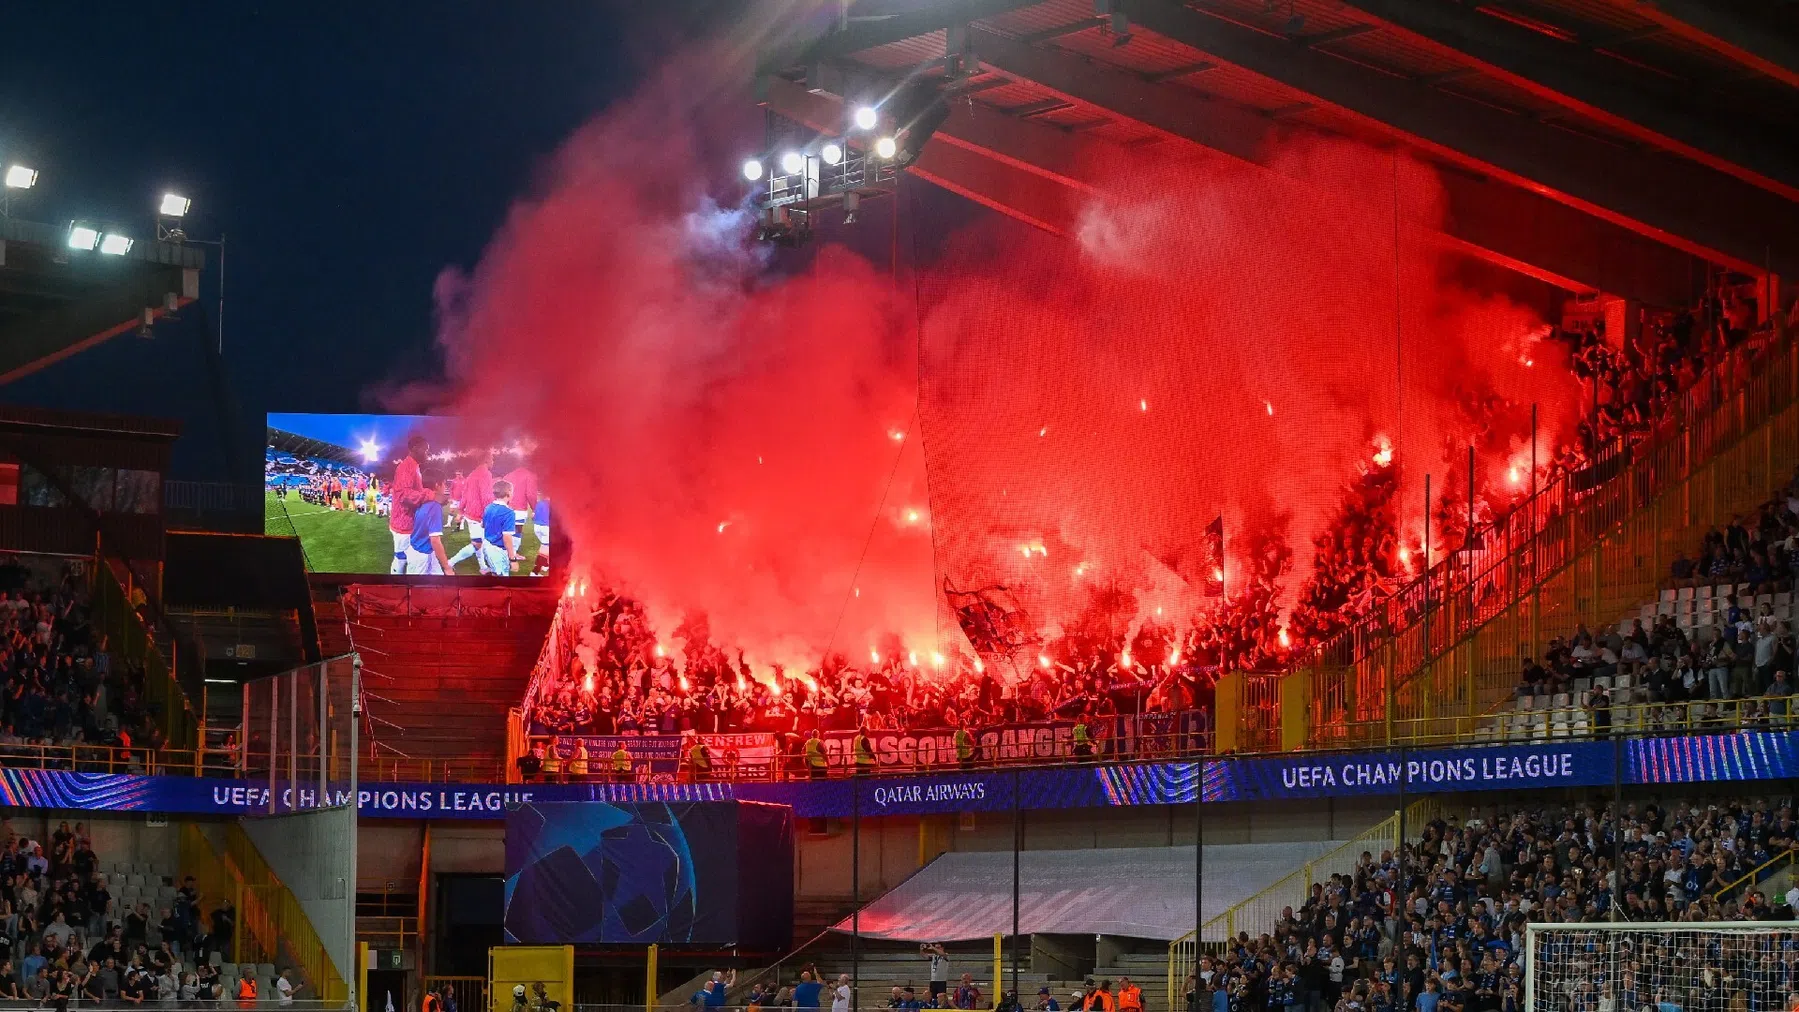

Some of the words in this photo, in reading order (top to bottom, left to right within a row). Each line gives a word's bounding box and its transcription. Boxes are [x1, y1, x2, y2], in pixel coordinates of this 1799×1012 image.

[703, 735, 766, 747] ENFREW
[711, 765, 767, 778] ANGERS
[1282, 765, 1336, 788] UEFA
[1342, 758, 1476, 786] CHAMPIONS
[1482, 753, 1573, 780] LEAGUE
[213, 786, 270, 806] UEFA
[282, 788, 432, 811] CHAMPIONS
[439, 791, 534, 811] LEAGUE
[874, 785, 922, 807] QATAR
[925, 782, 985, 802] AIRWAYS
